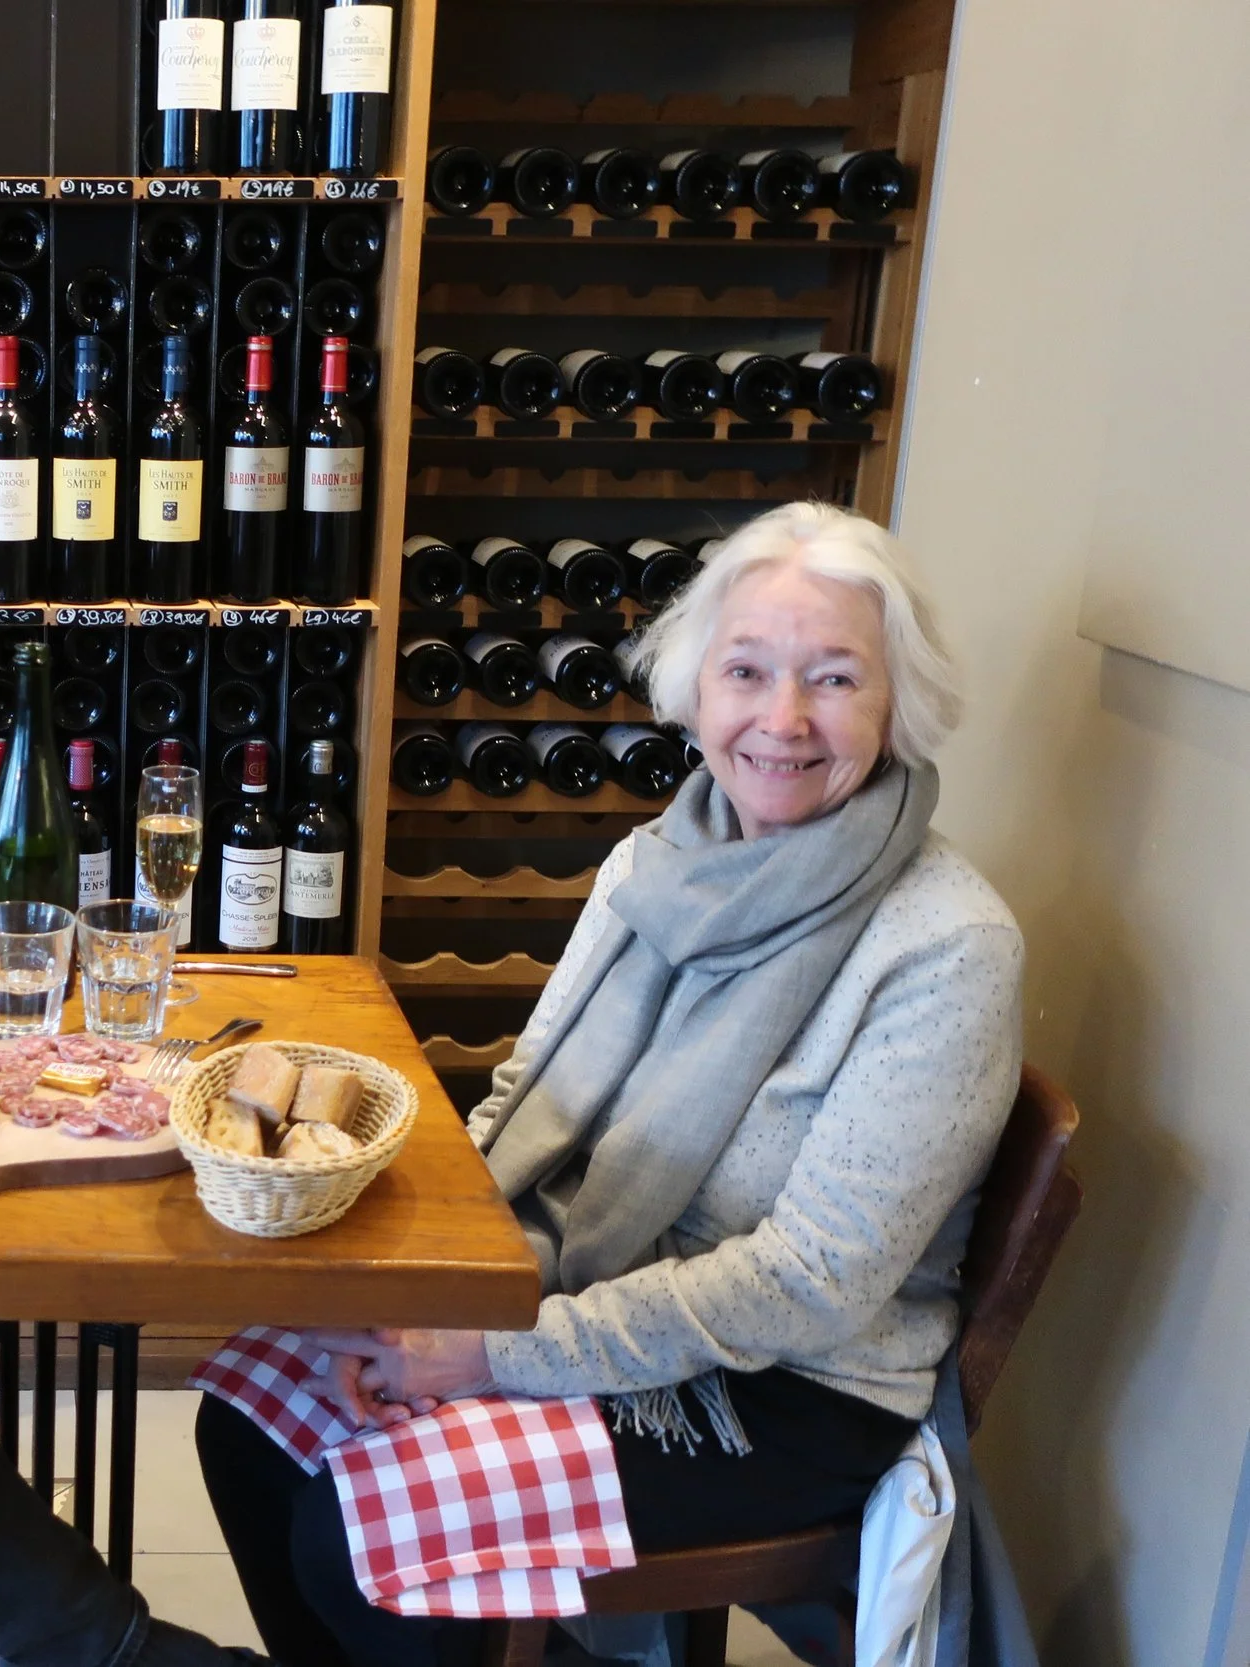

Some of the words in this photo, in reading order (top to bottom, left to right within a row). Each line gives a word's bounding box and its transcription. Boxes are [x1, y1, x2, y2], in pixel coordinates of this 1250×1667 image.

[230, 471, 256, 485] BARON
[311, 472, 339, 486] BARON
[66, 479, 101, 489] SMITH
[153, 481, 188, 491] SMITH
[80, 869, 104, 877] HÂTEAU
[222, 909, 278, 921] CHASSE-SPLEEN
